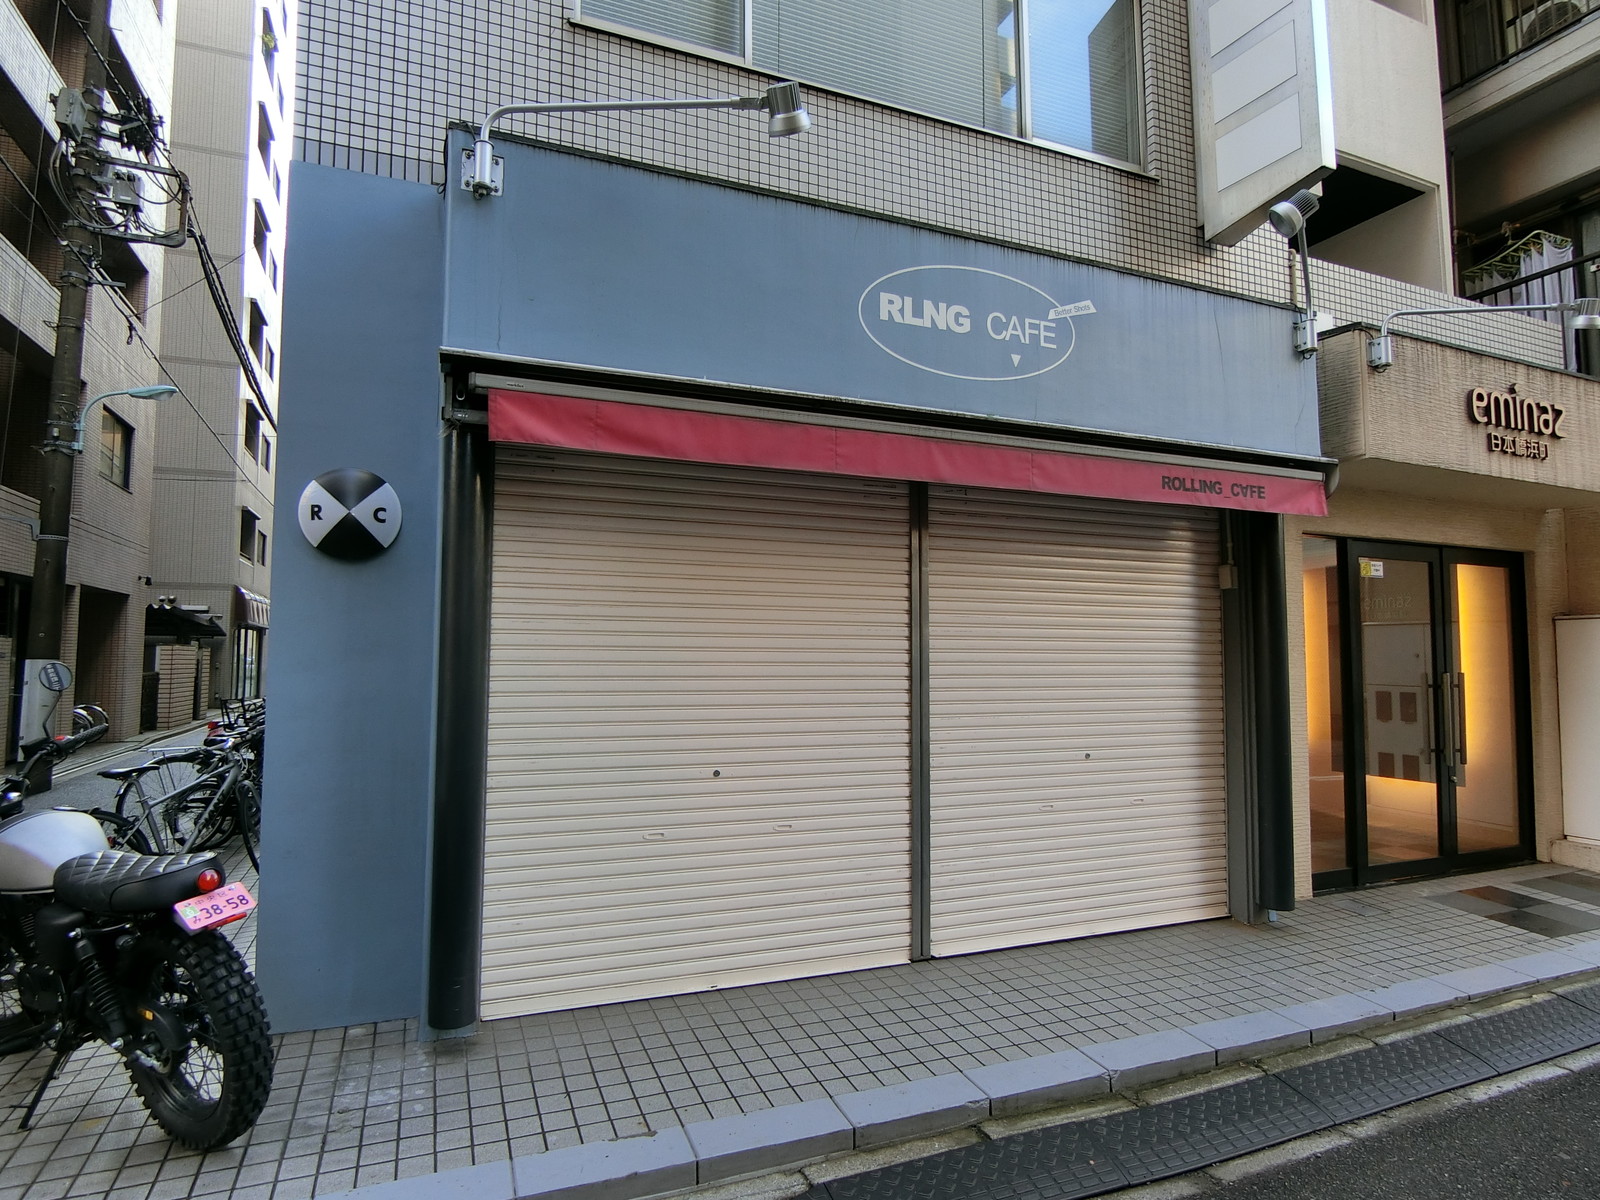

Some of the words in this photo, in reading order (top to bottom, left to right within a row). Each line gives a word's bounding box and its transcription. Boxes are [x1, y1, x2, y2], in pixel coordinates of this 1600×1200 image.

[880, 292, 971, 334] RLNG
[986, 312, 1057, 349] CAFE
[1054, 309, 1072, 317] Better
[1073, 305, 1091, 313] Shots
[1469, 384, 1567, 440] eminaz
[1489, 432, 1550, 460] 日本橋浜町
[310, 504, 323, 521] R
[373, 507, 387, 523] C
[200, 894, 249, 919] 38-58
